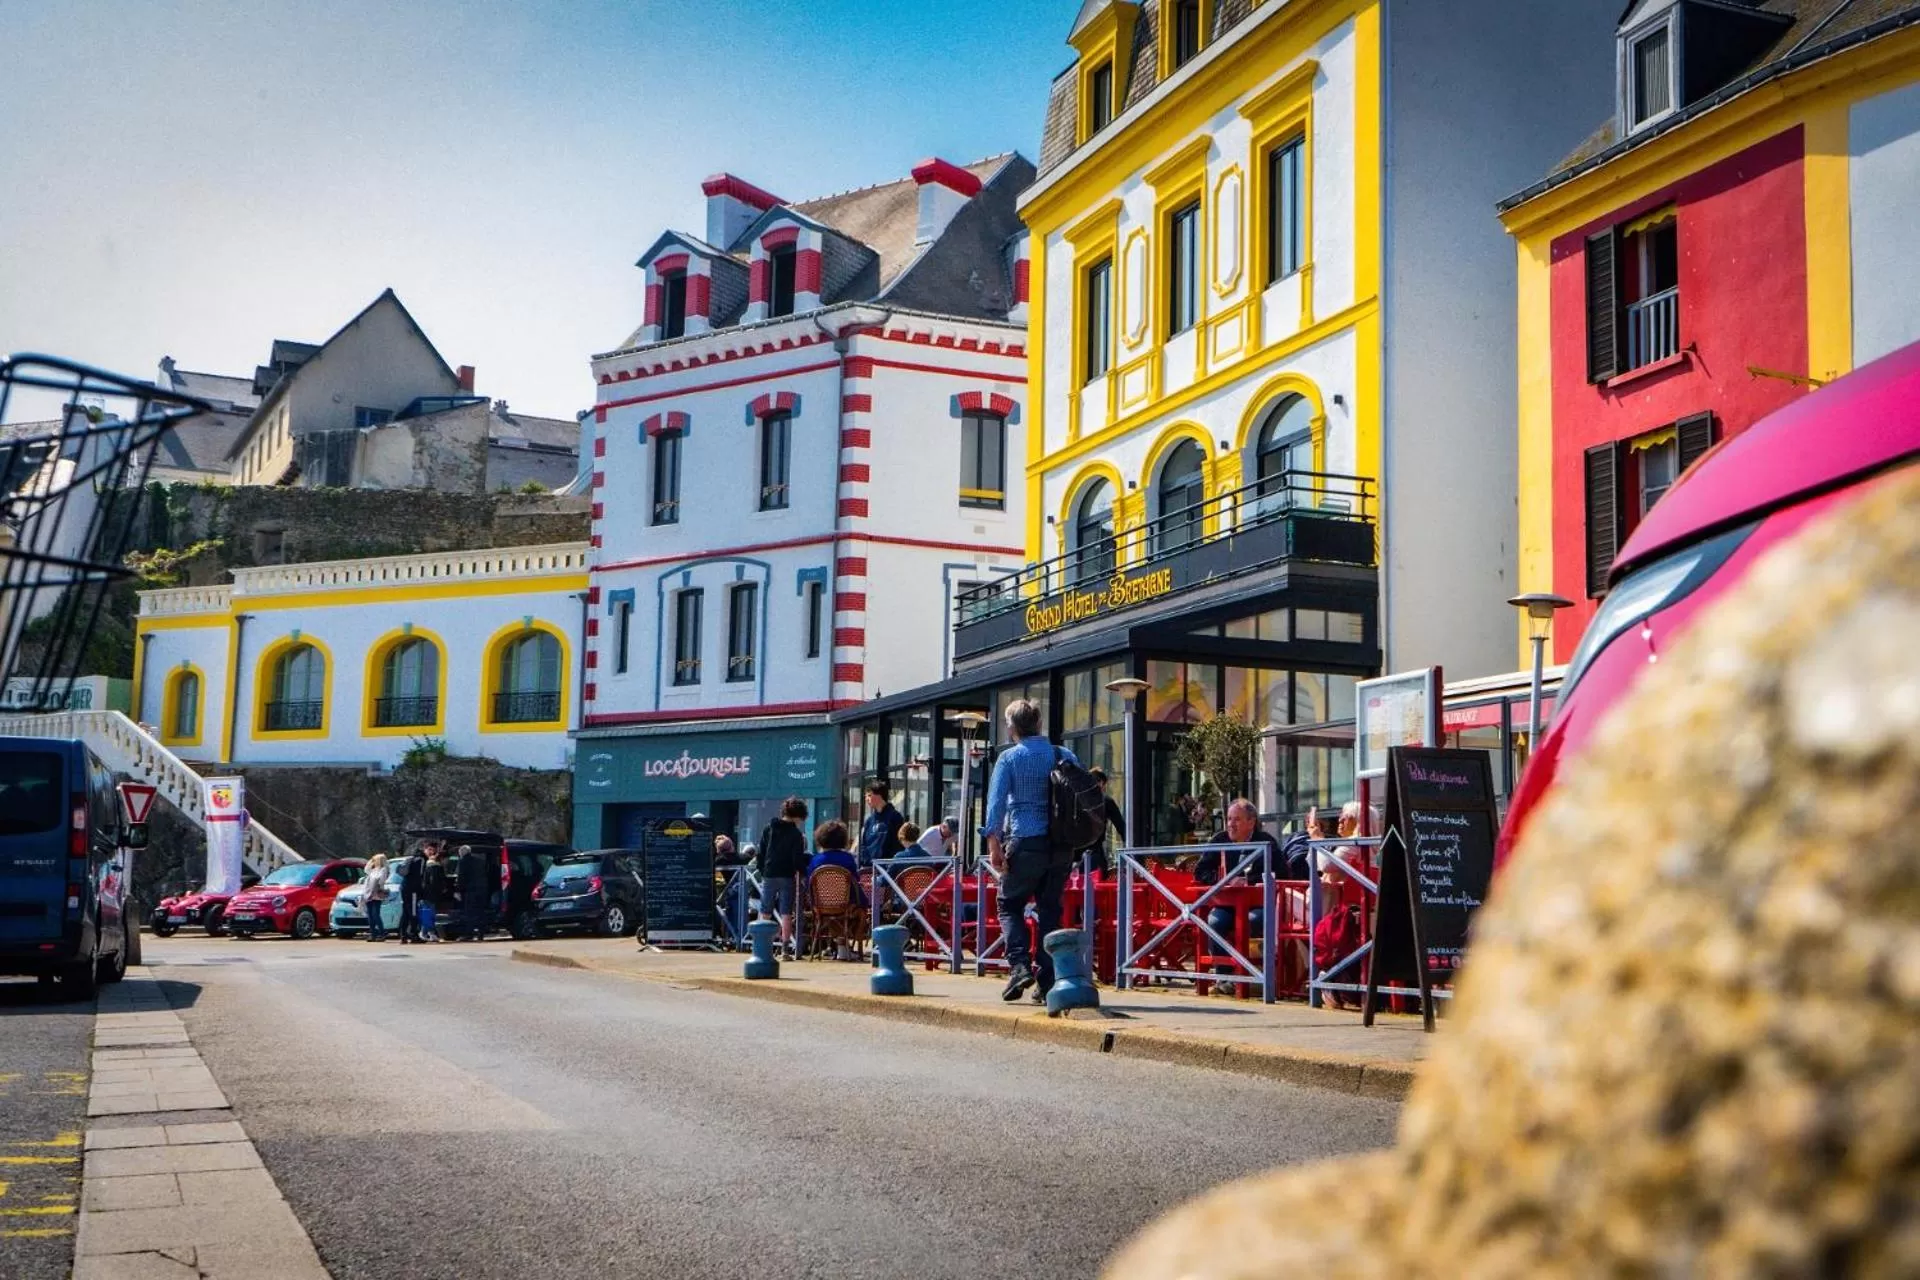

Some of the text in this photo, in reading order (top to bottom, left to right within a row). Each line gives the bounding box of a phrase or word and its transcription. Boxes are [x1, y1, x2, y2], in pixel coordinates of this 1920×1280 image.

[1026, 604, 1061, 632] GRAND
[1108, 568, 1171, 608] BRETAGNE
[644, 749, 751, 778] LOCATOURISLE
